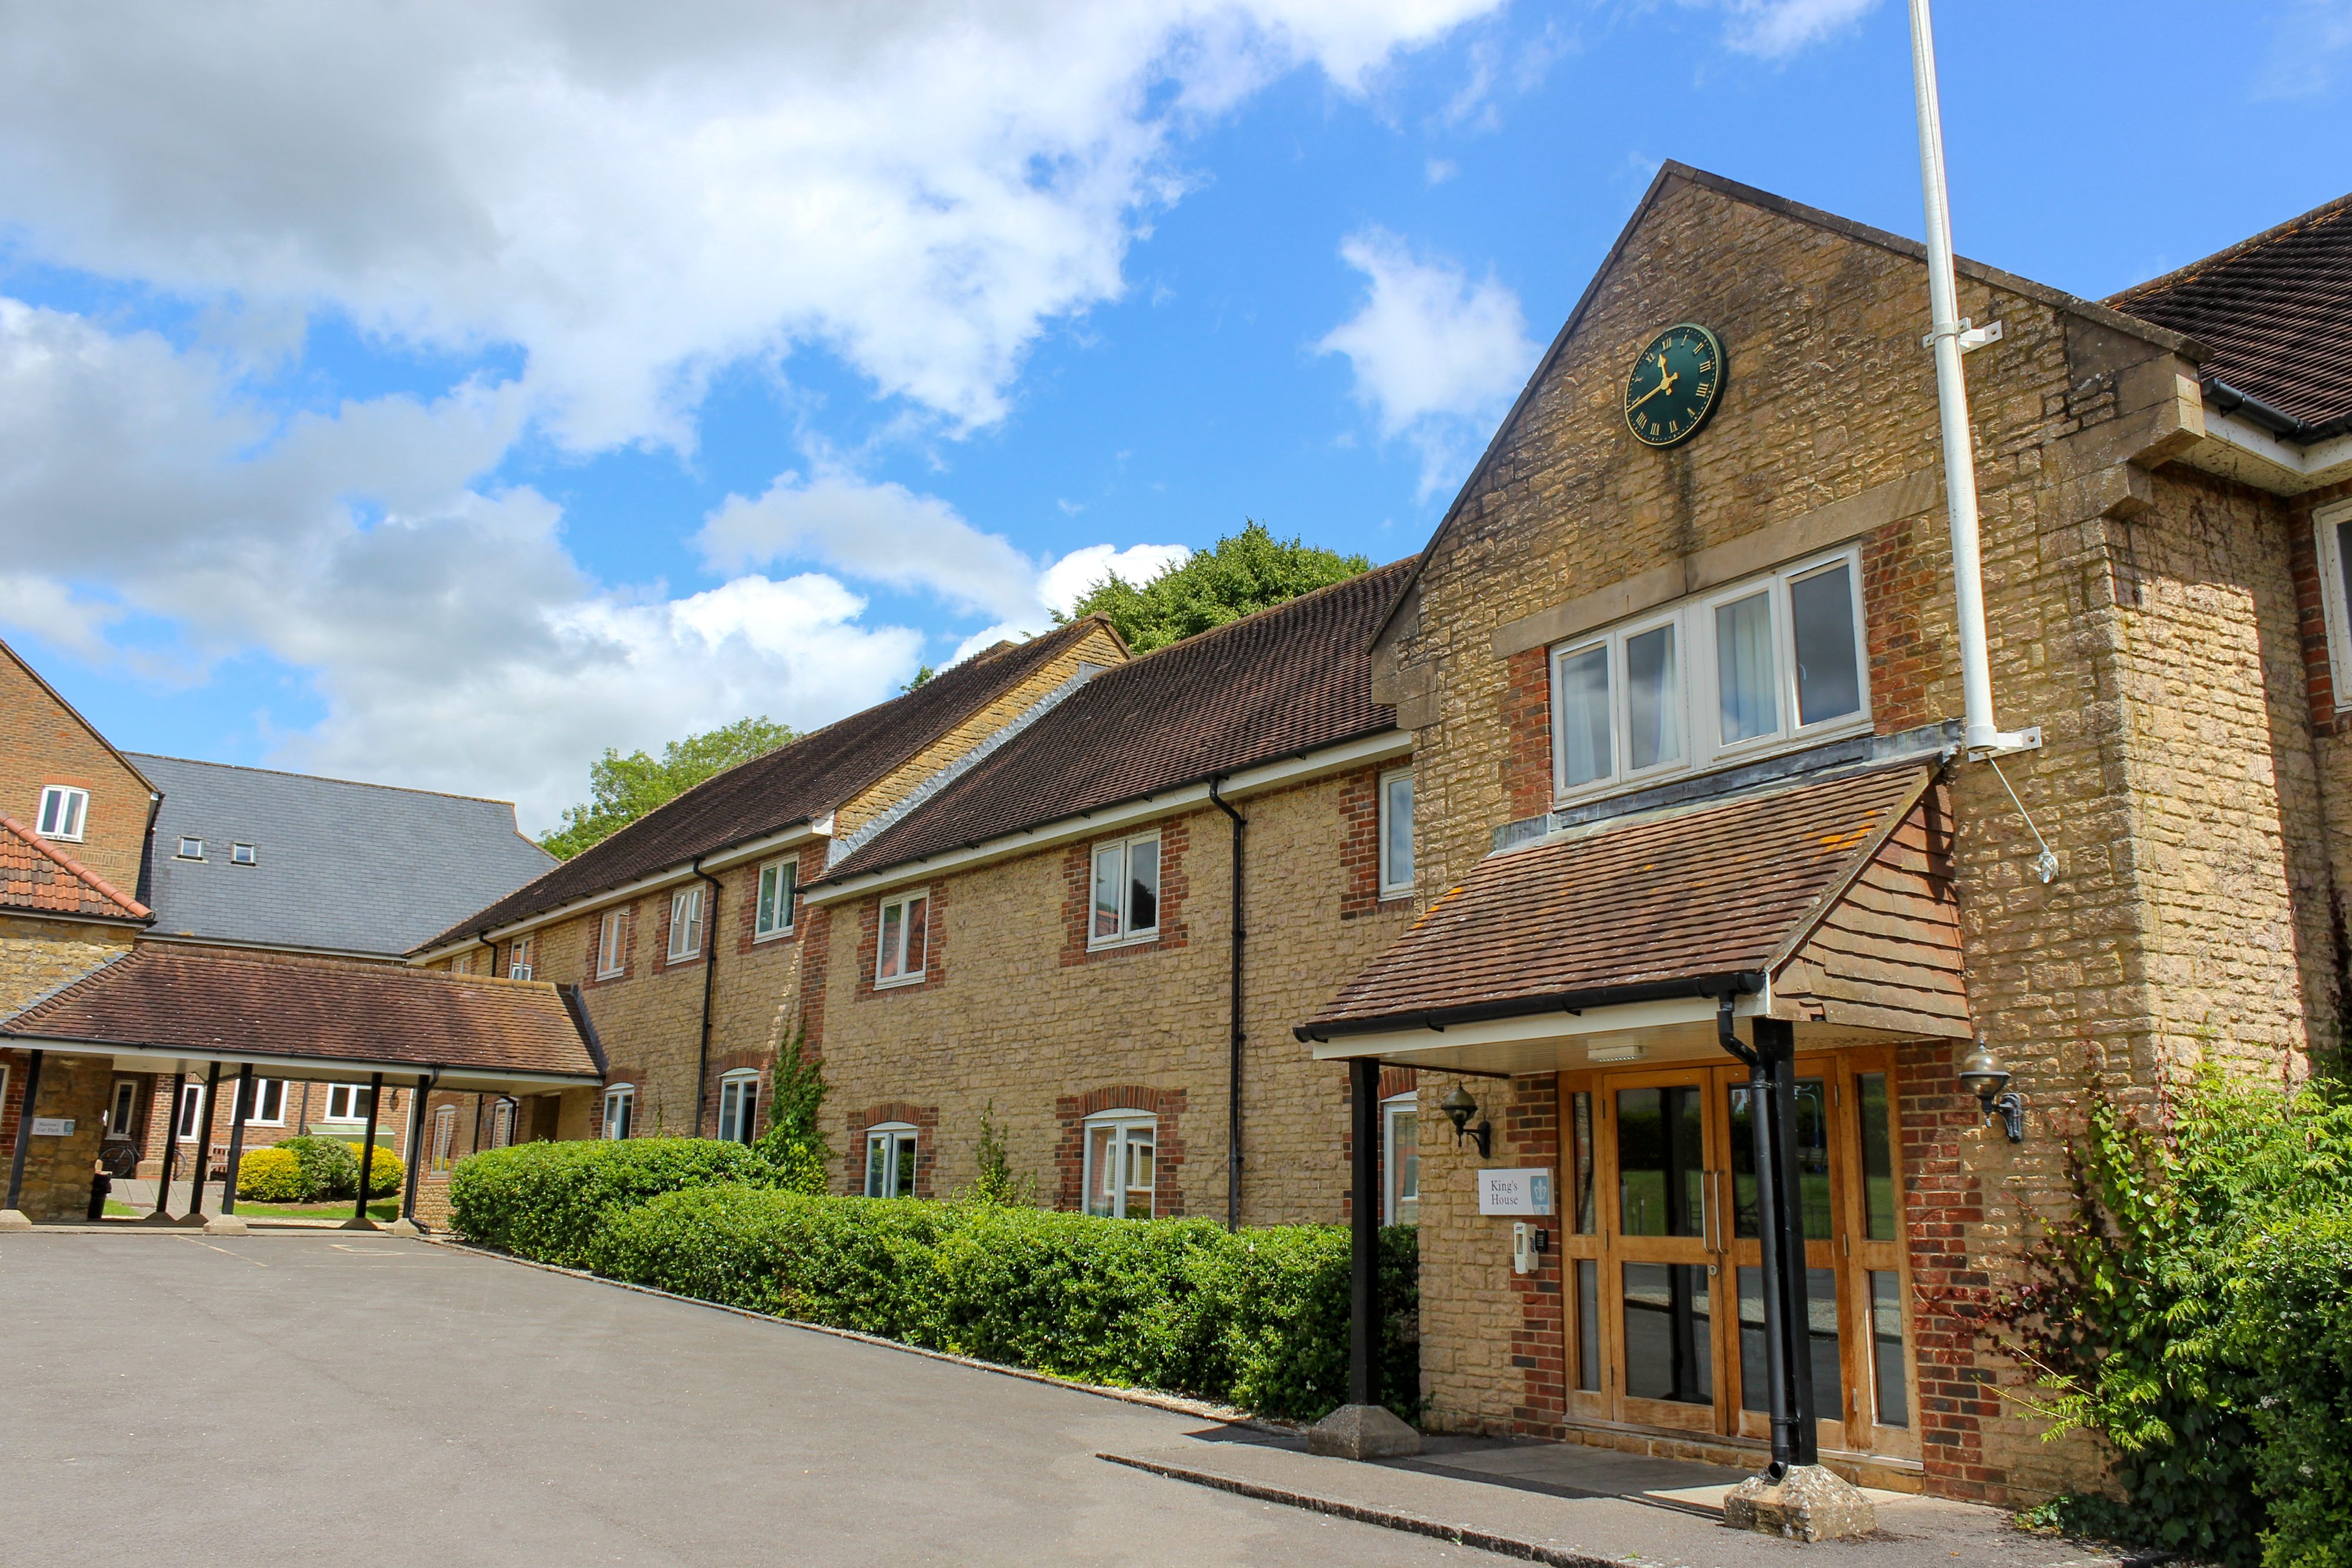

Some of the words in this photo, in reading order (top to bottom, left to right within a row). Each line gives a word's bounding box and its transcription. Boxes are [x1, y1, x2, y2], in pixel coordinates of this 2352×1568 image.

[1662, 337, 1672, 350] XII
[1693, 342, 1704, 355] II
[1699, 360, 1711, 373] III
[1695, 382, 1710, 397] IIII
[1636, 412, 1648, 430] VIII
[1669, 420, 1678, 433] VI
[1650, 423, 1661, 436] VII
[1491, 1180, 1518, 1193] King's
[1491, 1193, 1518, 1205] House
